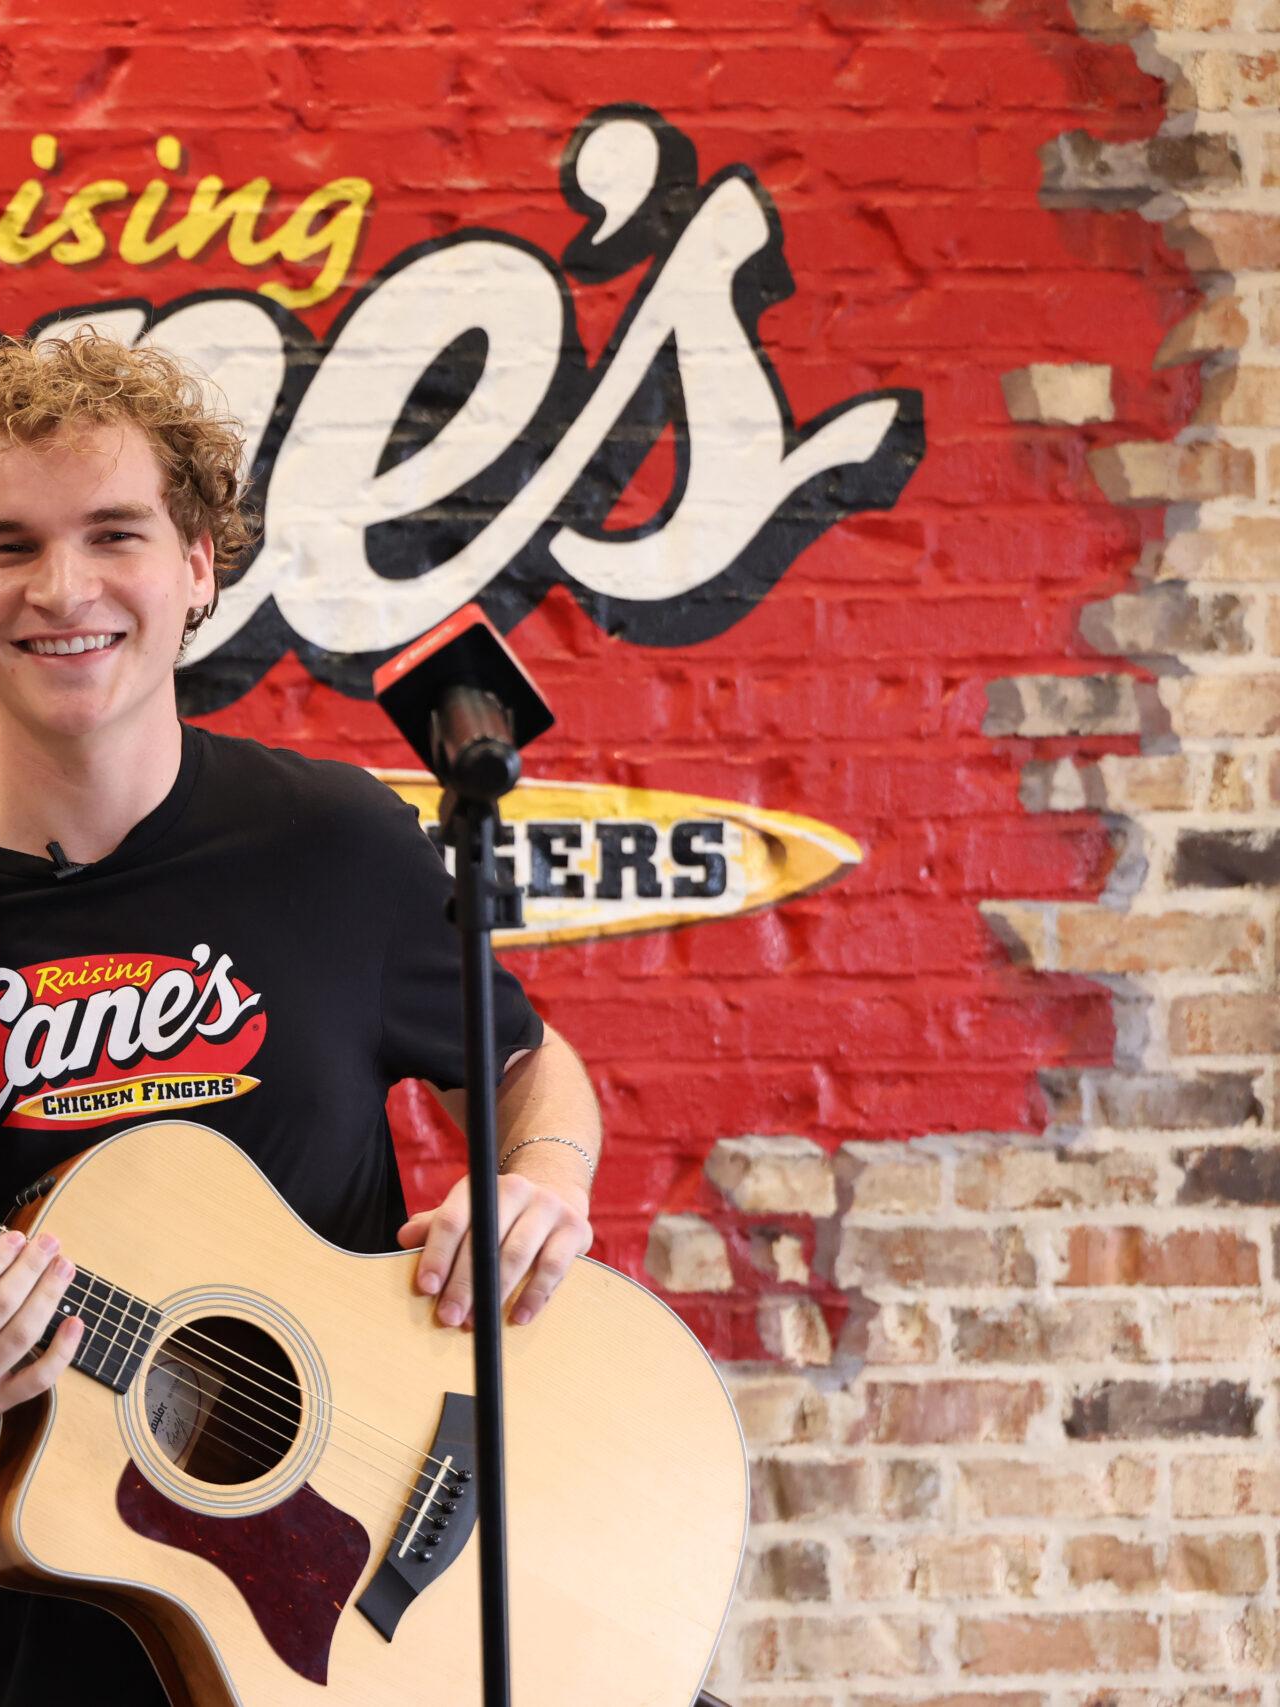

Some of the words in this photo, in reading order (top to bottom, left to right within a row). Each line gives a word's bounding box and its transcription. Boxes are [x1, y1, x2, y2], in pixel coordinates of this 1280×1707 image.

[35, 957, 153, 998] Raising
[42, 1087, 133, 1116] CHICKEN
[141, 1077, 235, 1102] FINGERS
[150, 1401, 167, 1435] aylor
